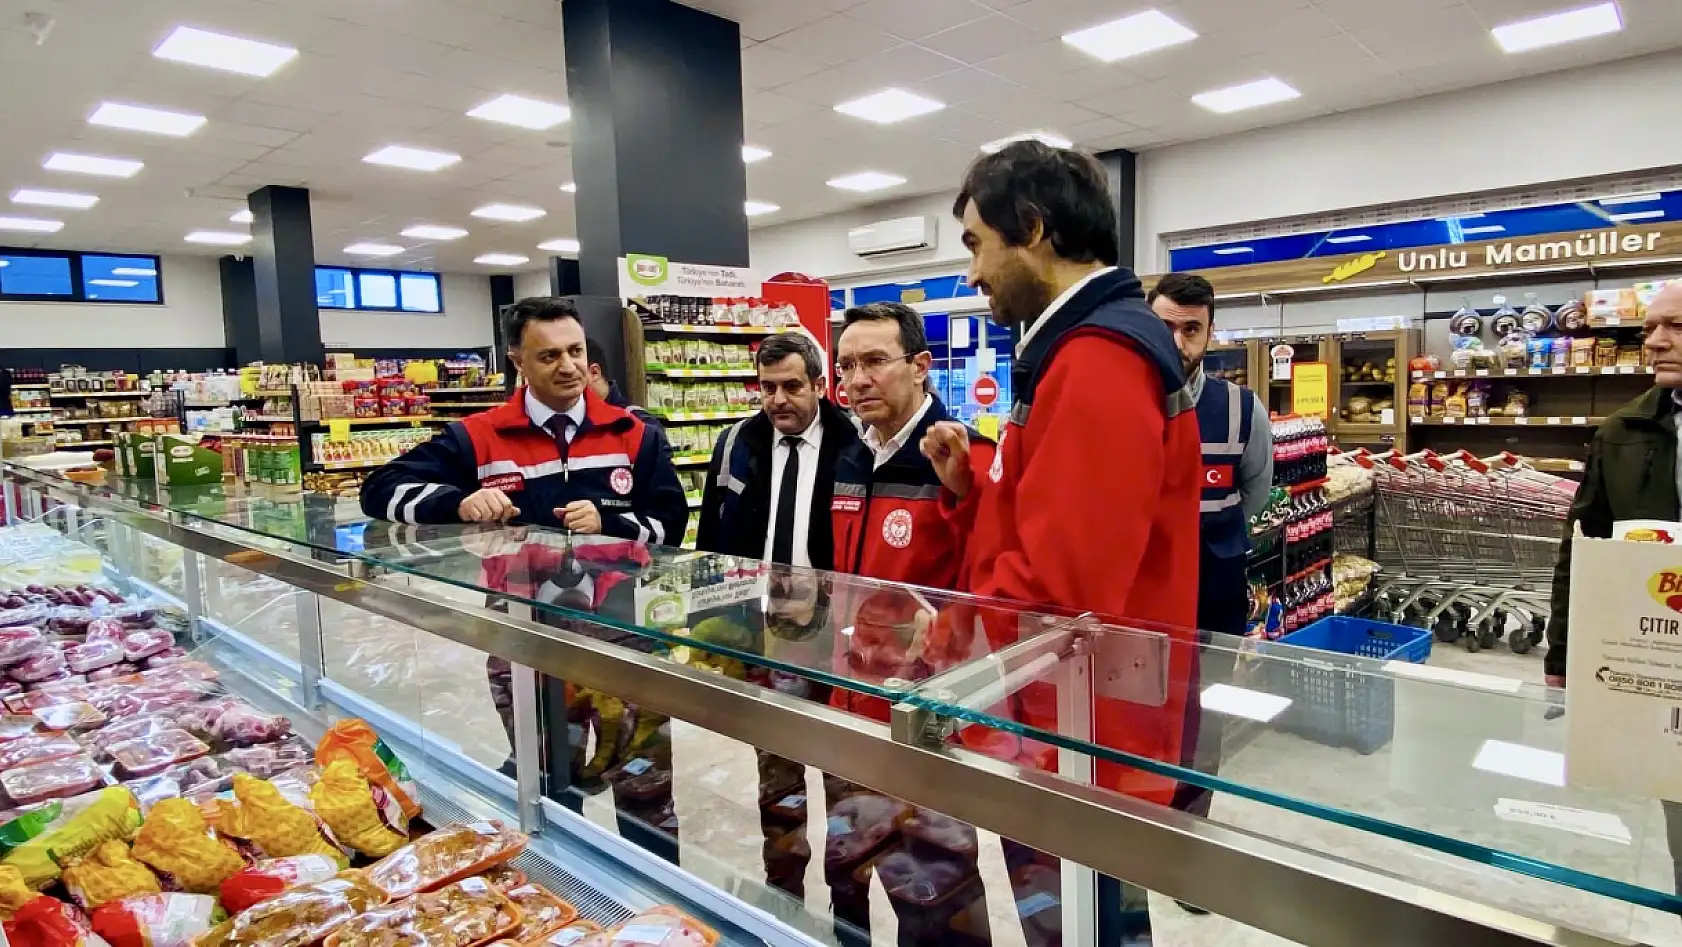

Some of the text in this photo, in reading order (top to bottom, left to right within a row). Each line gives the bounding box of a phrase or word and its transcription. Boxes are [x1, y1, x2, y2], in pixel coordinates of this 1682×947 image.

[1397, 230, 1662, 272] Unlu Mamüller
[1639, 616, 1679, 635] ÇITIR
